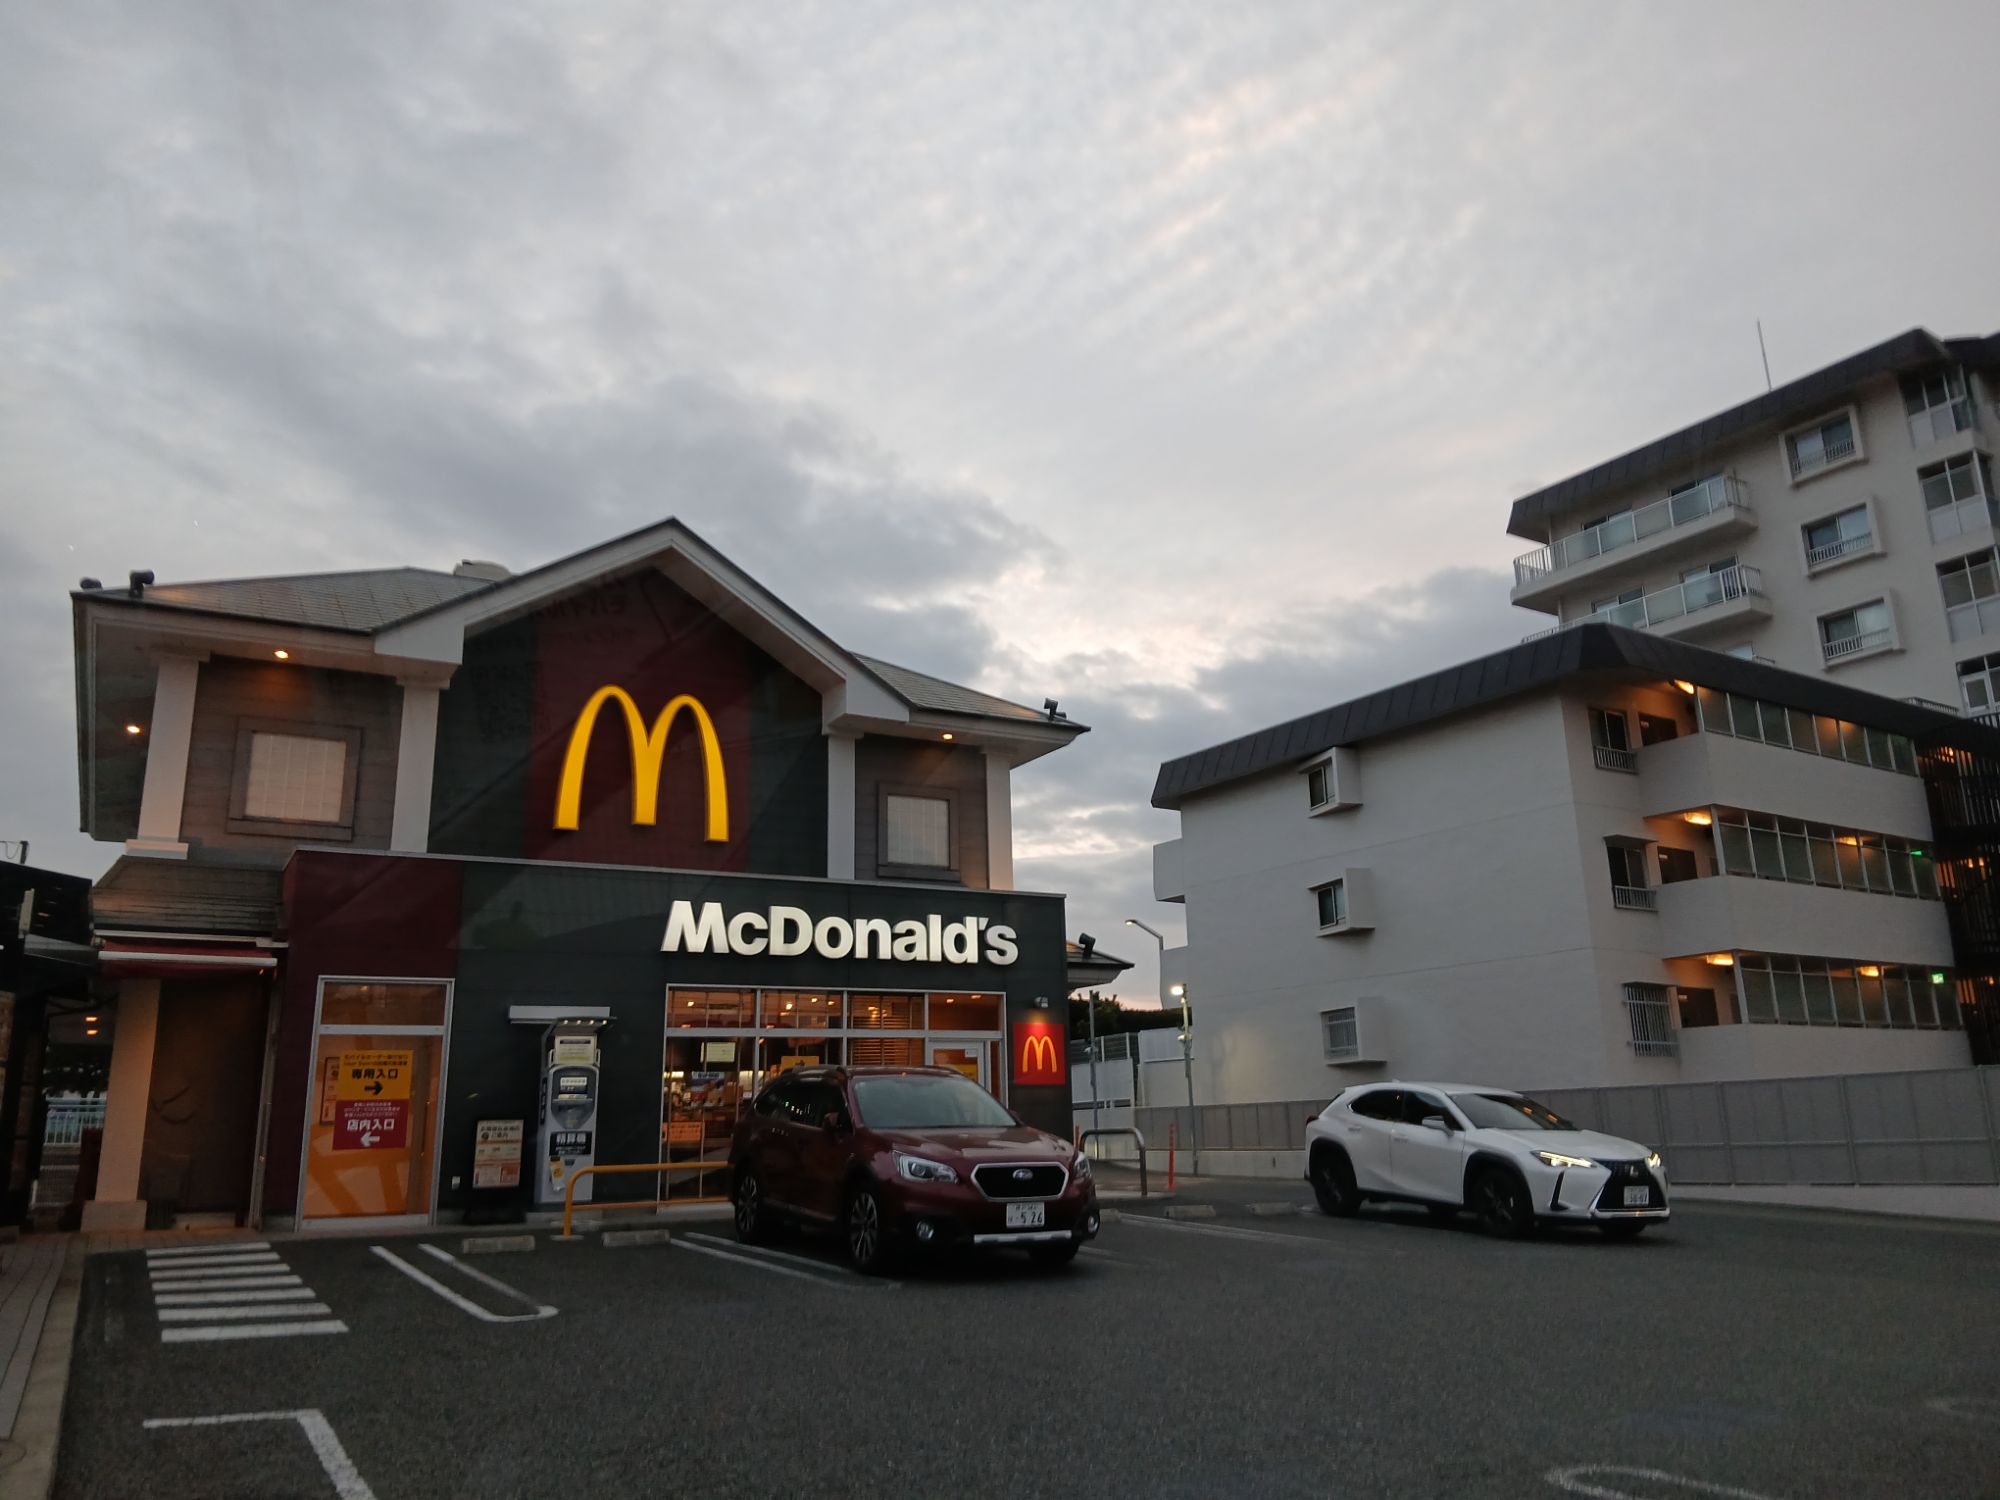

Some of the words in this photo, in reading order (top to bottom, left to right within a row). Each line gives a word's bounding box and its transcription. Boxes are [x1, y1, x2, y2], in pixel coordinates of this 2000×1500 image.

[661, 900, 1019, 966] McDonald's
[352, 1068, 399, 1079] 専用入口
[346, 1119, 395, 1131] 店内入口
